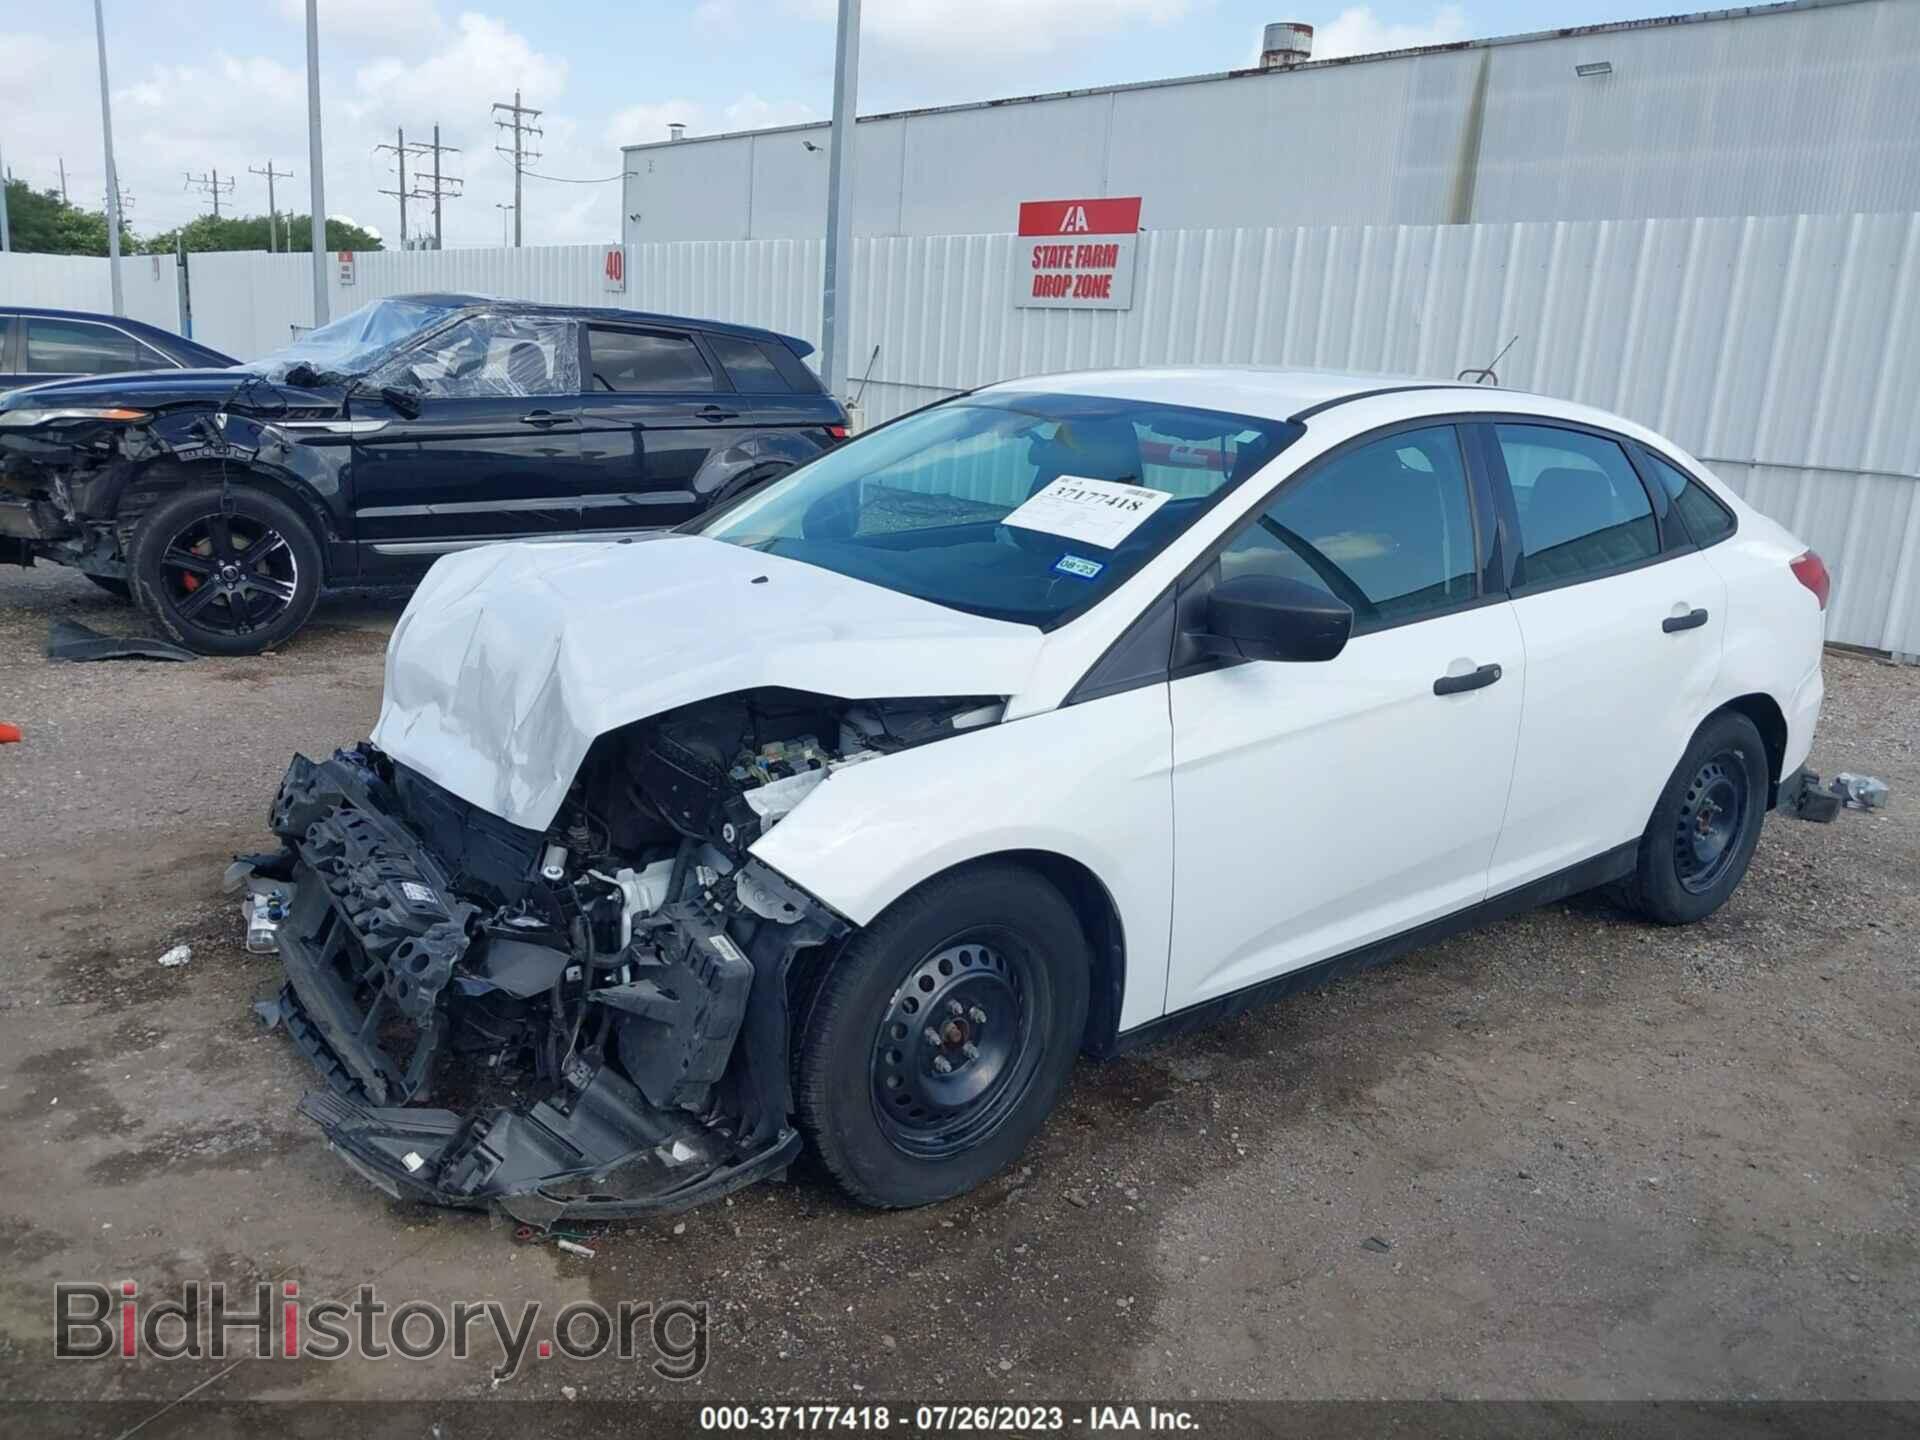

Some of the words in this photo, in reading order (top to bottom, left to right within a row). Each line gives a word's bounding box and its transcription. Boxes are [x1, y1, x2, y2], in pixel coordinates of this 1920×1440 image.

[606, 251, 621, 280] 40
[1032, 245, 1074, 269] STATE
[1075, 244, 1119, 268] FARM
[1032, 274, 1072, 298] DROP
[1072, 274, 1112, 298] ZONE
[1049, 486, 1143, 511] 37177418
